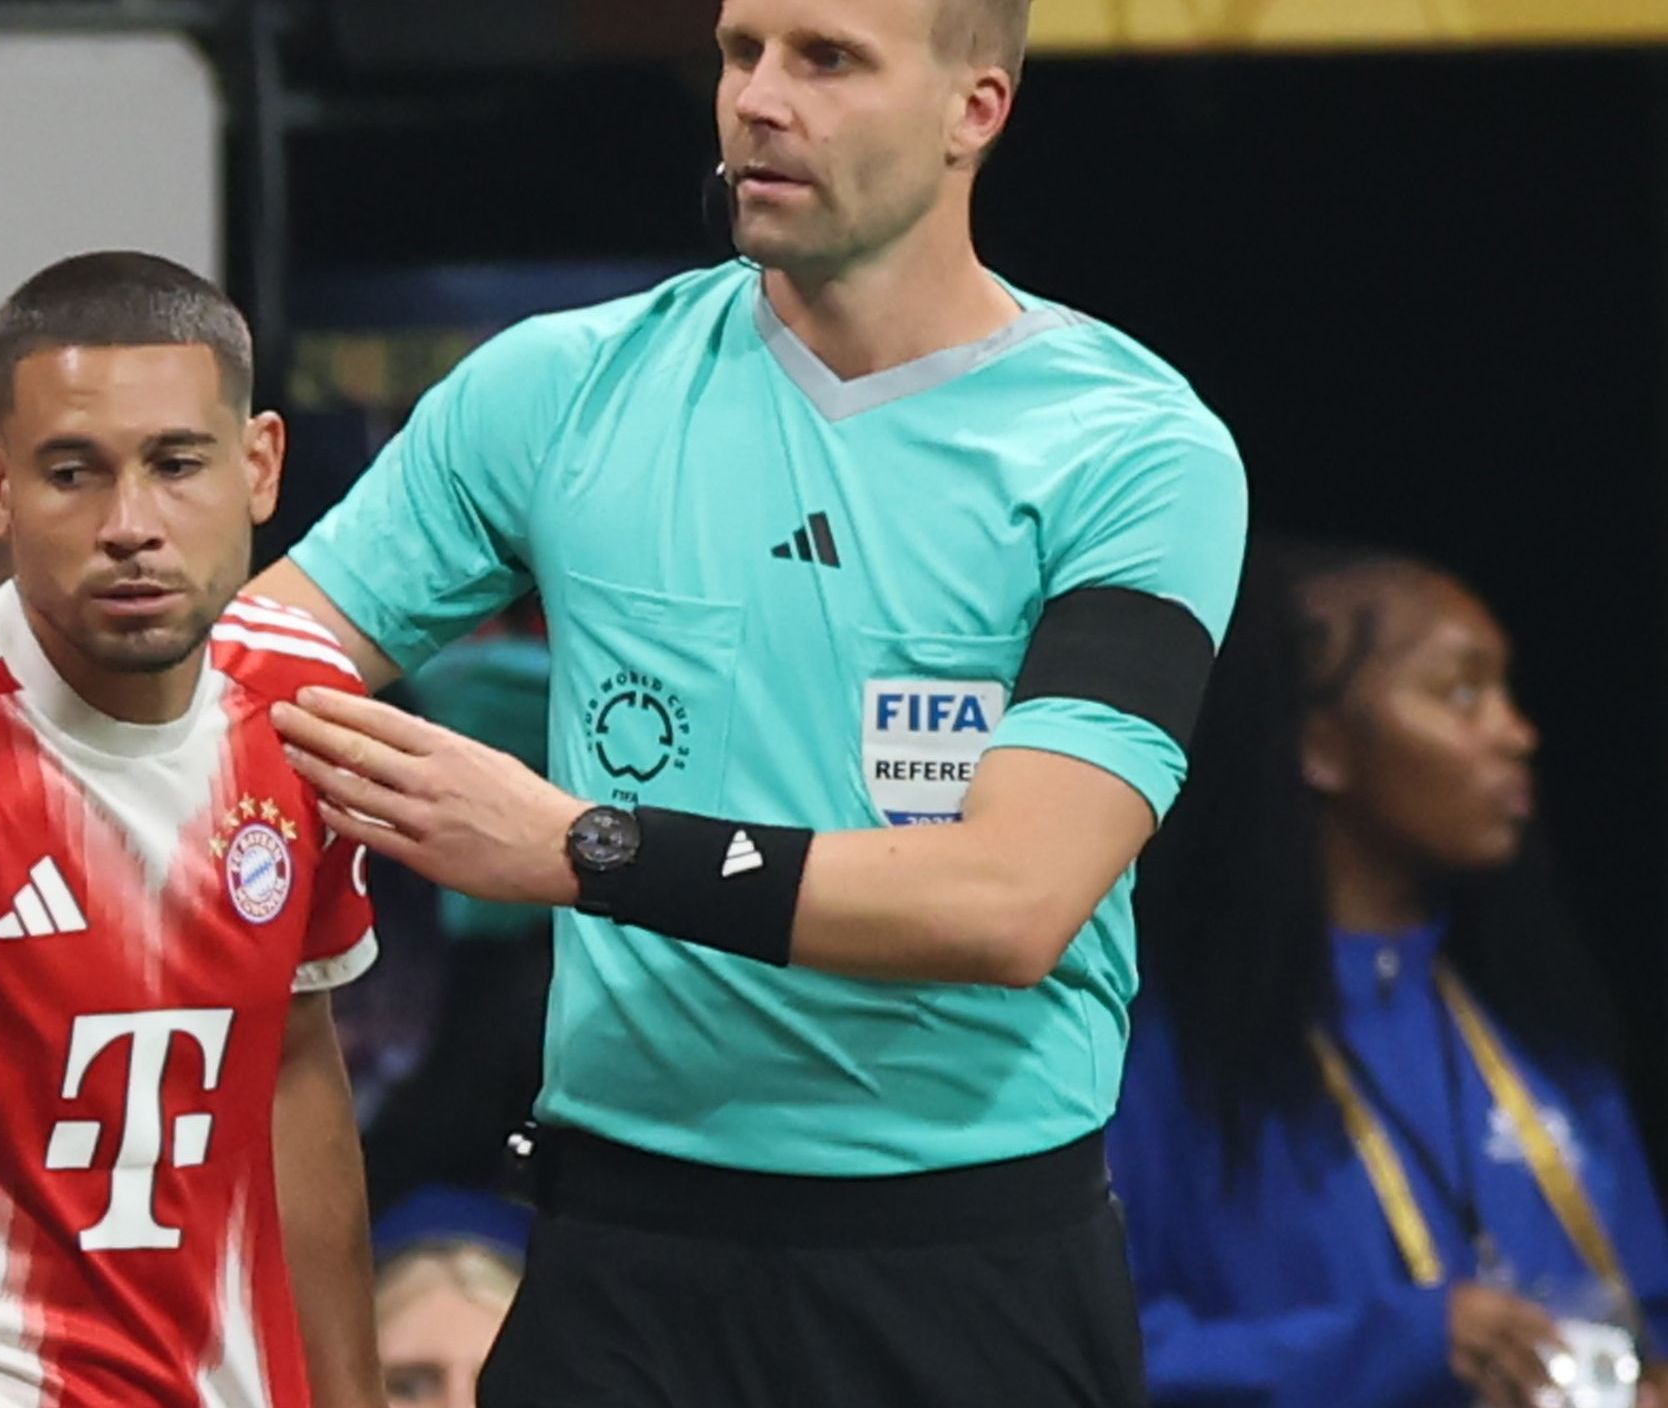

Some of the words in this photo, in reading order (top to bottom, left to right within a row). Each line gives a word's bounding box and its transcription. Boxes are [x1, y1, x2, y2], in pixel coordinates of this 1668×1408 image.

[600, 670, 663, 693] WORLD
[667, 694, 690, 735] CUP
[876, 693, 990, 733] FIFA
[875, 759, 978, 782] REFERE
